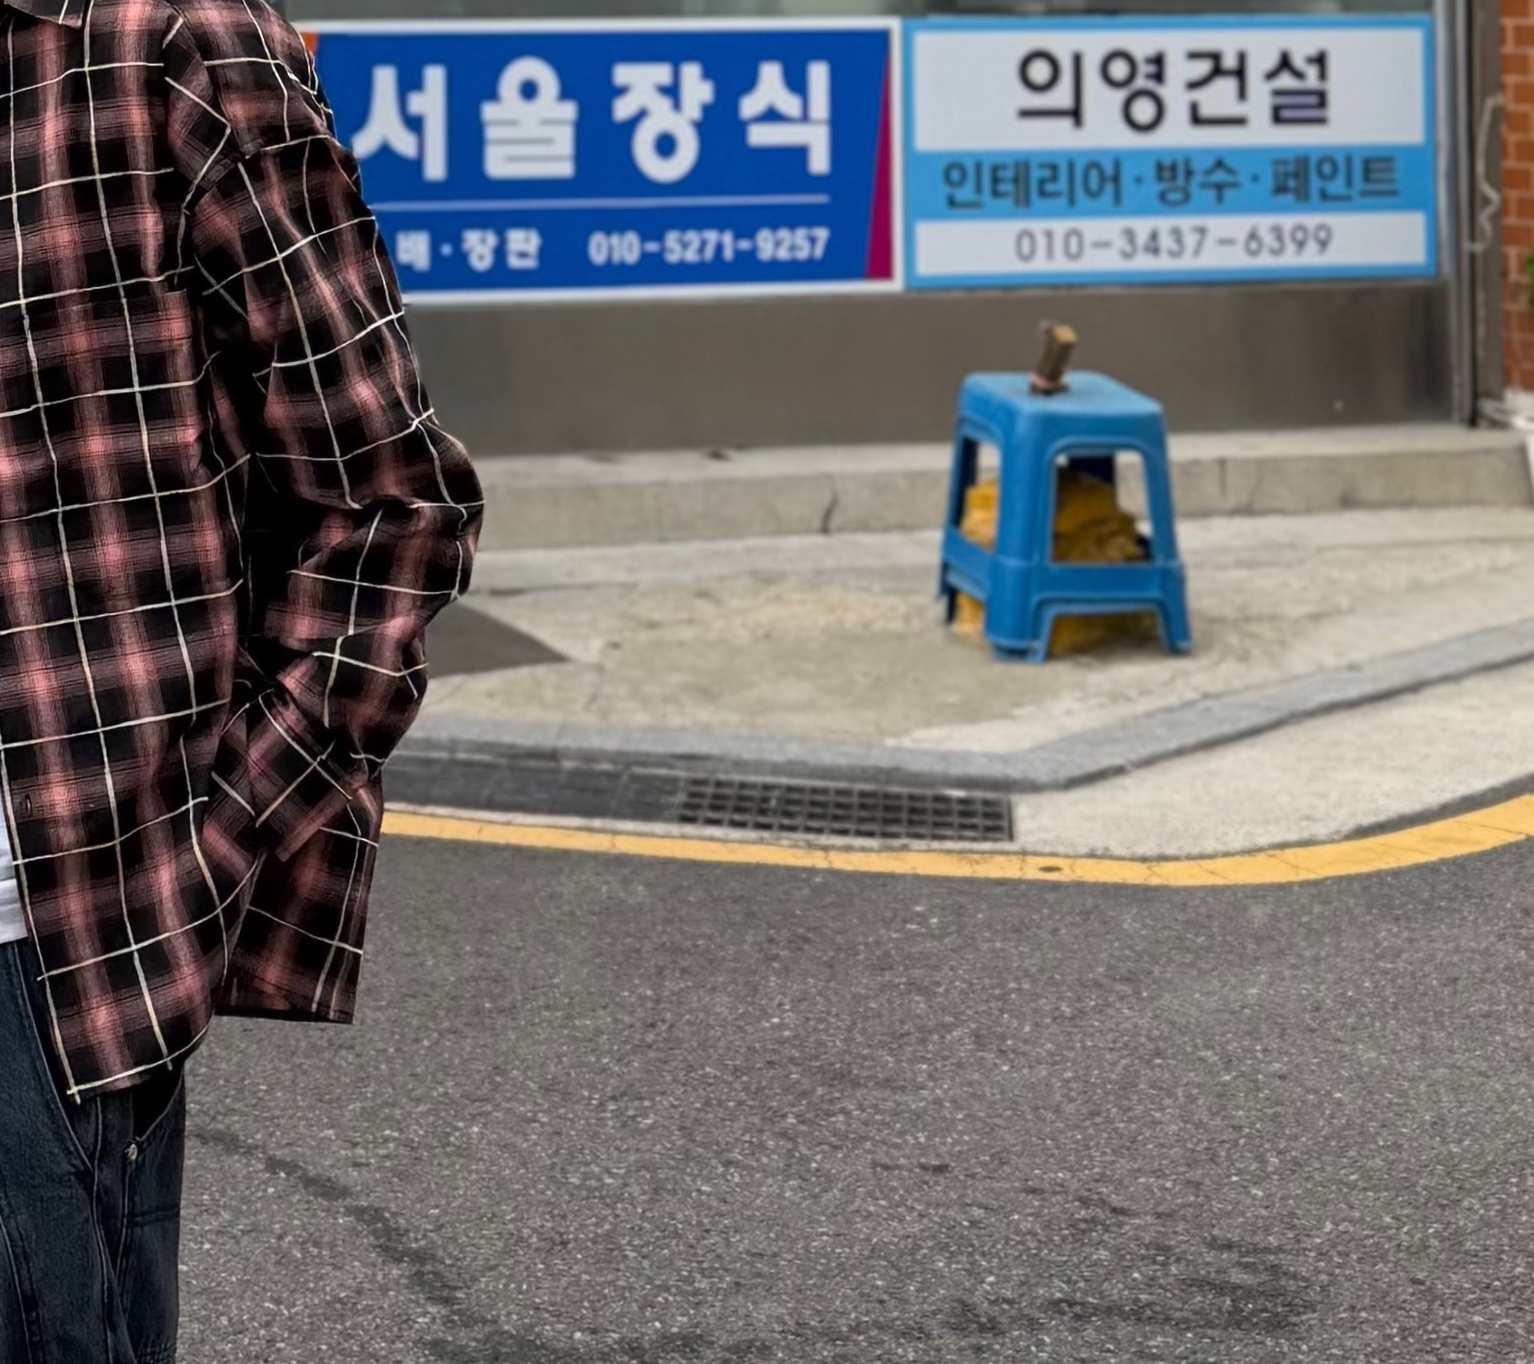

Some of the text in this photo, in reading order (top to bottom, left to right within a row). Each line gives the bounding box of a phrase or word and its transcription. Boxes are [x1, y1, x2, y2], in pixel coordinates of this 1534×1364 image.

[1016, 49, 1330, 134] 의영건설
[587, 226, 831, 266] 010-5271-9257
[1015, 223, 1334, 264] 010-3437-6399
